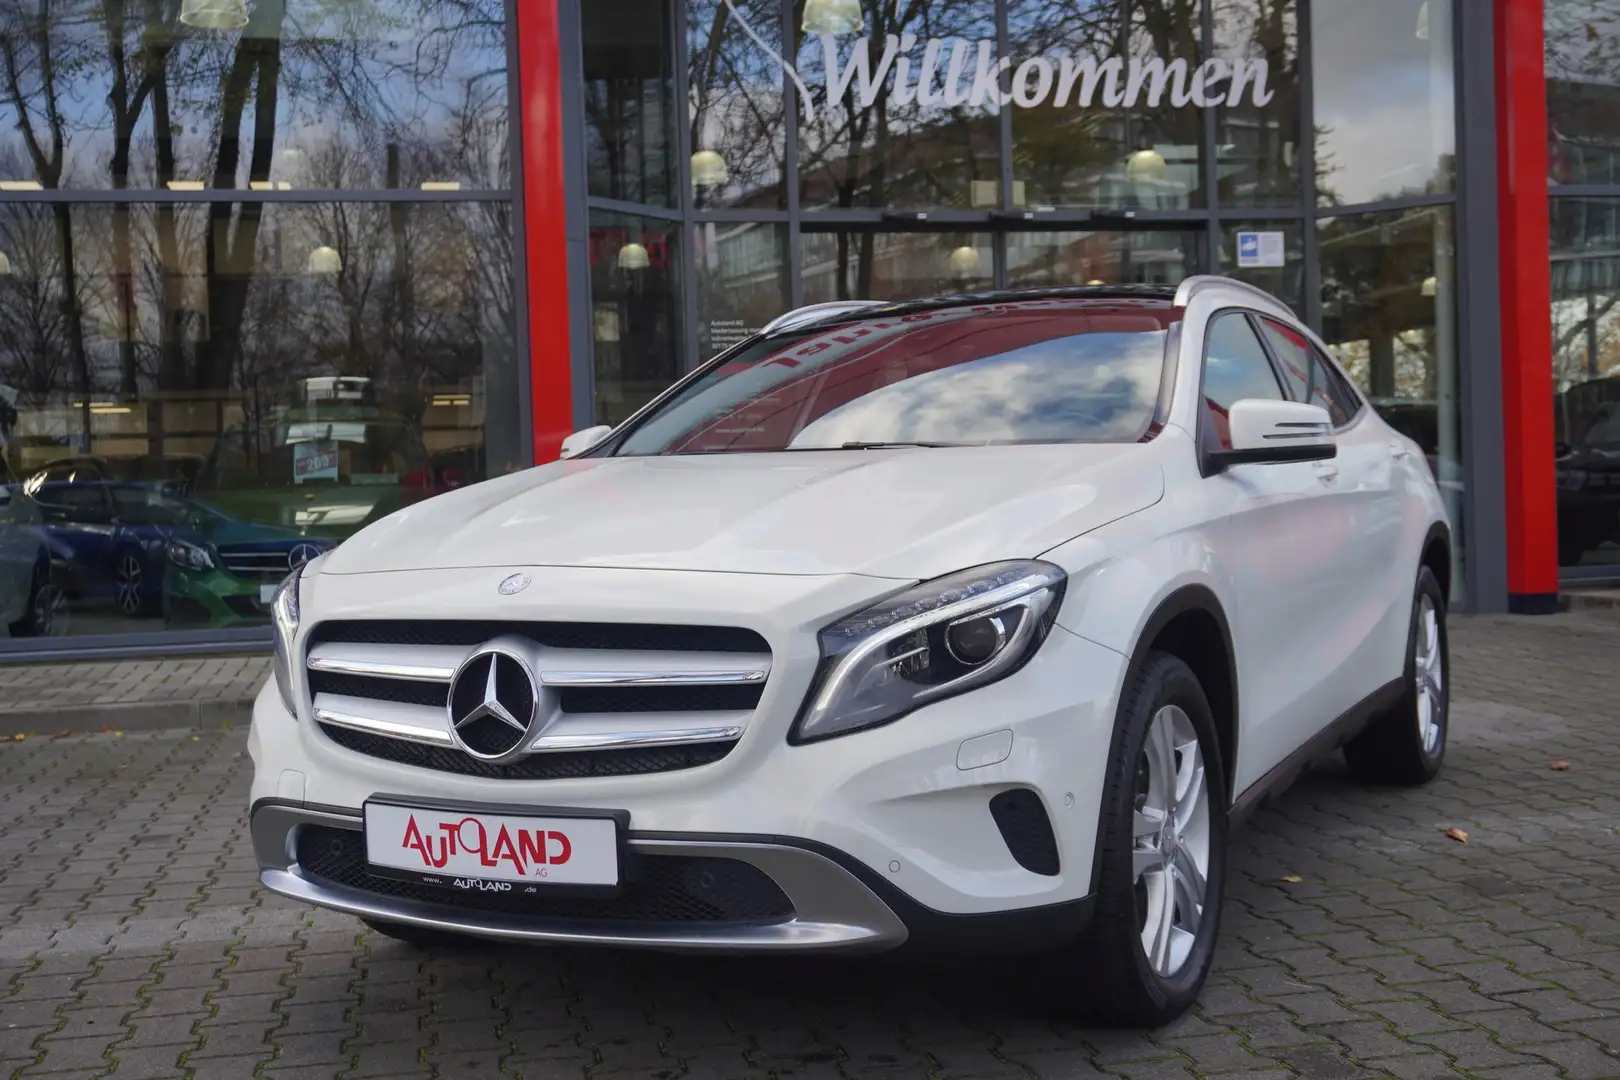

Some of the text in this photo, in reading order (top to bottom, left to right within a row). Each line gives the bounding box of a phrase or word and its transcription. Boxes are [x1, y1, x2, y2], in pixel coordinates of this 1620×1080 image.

[821, 34, 1274, 109] Willkommen
[534, 868, 548, 877] AG
[423, 876, 442, 884] www.
